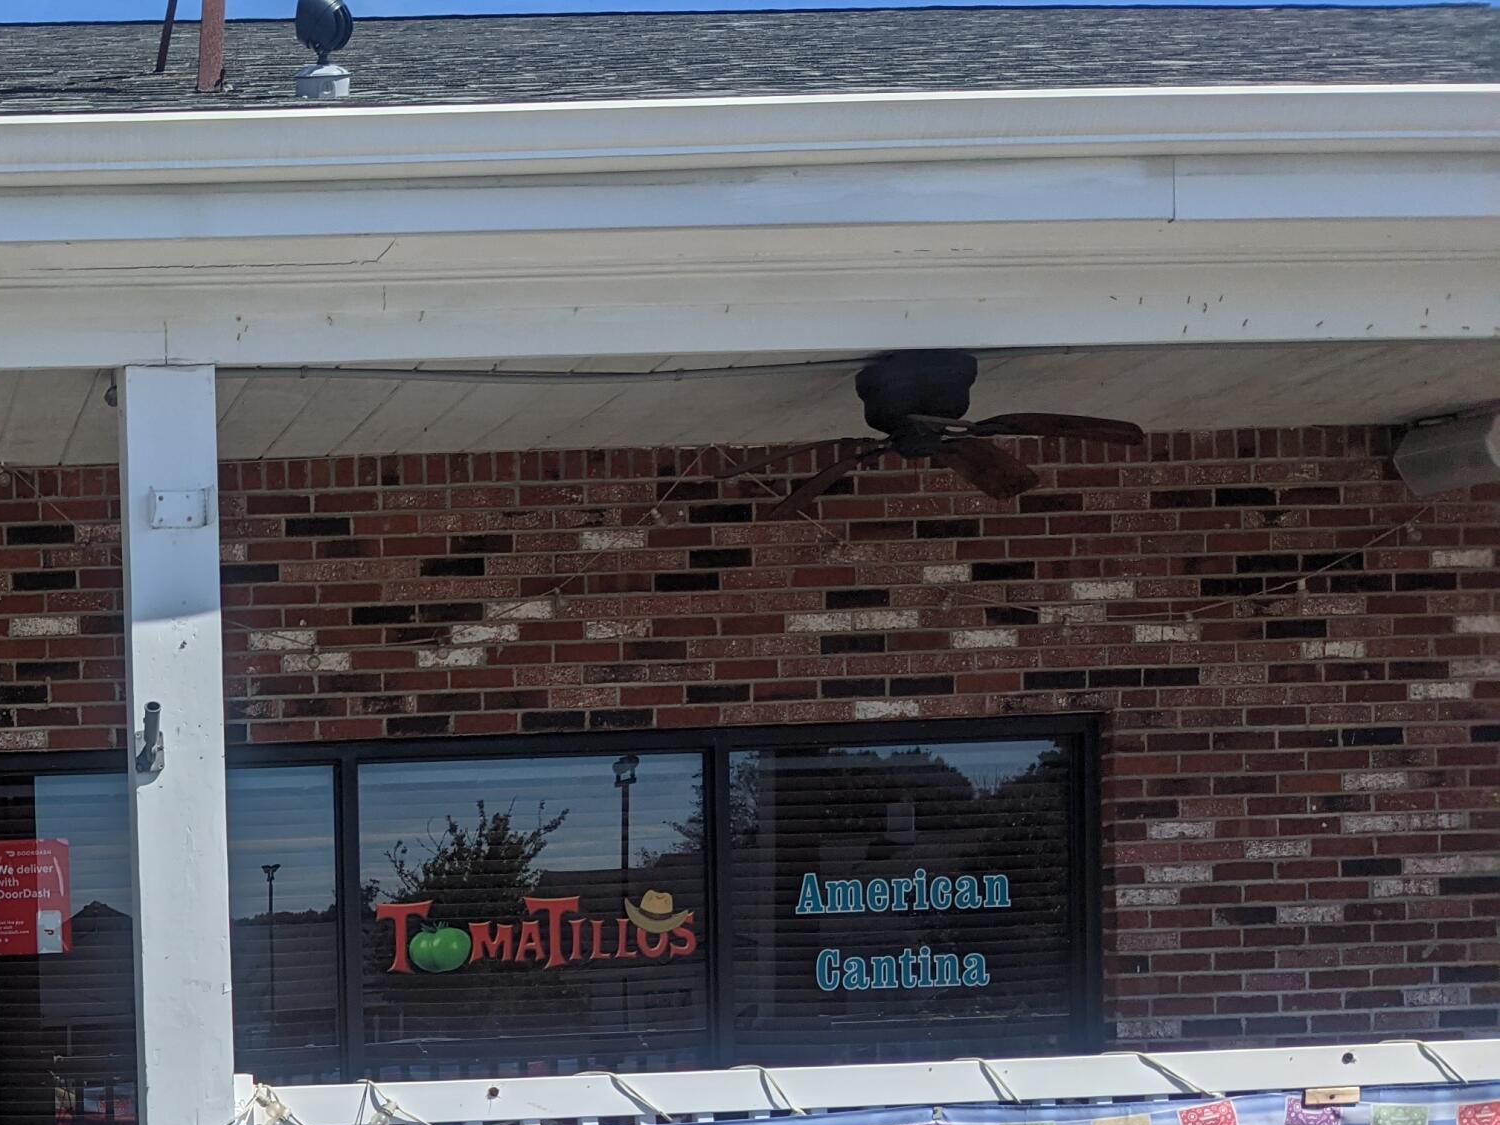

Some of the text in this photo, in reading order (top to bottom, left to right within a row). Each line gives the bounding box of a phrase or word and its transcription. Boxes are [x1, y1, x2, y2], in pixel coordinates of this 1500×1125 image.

[16, 864, 54, 874] deliver
[795, 868, 1012, 915] American
[815, 945, 991, 992] Cantina
